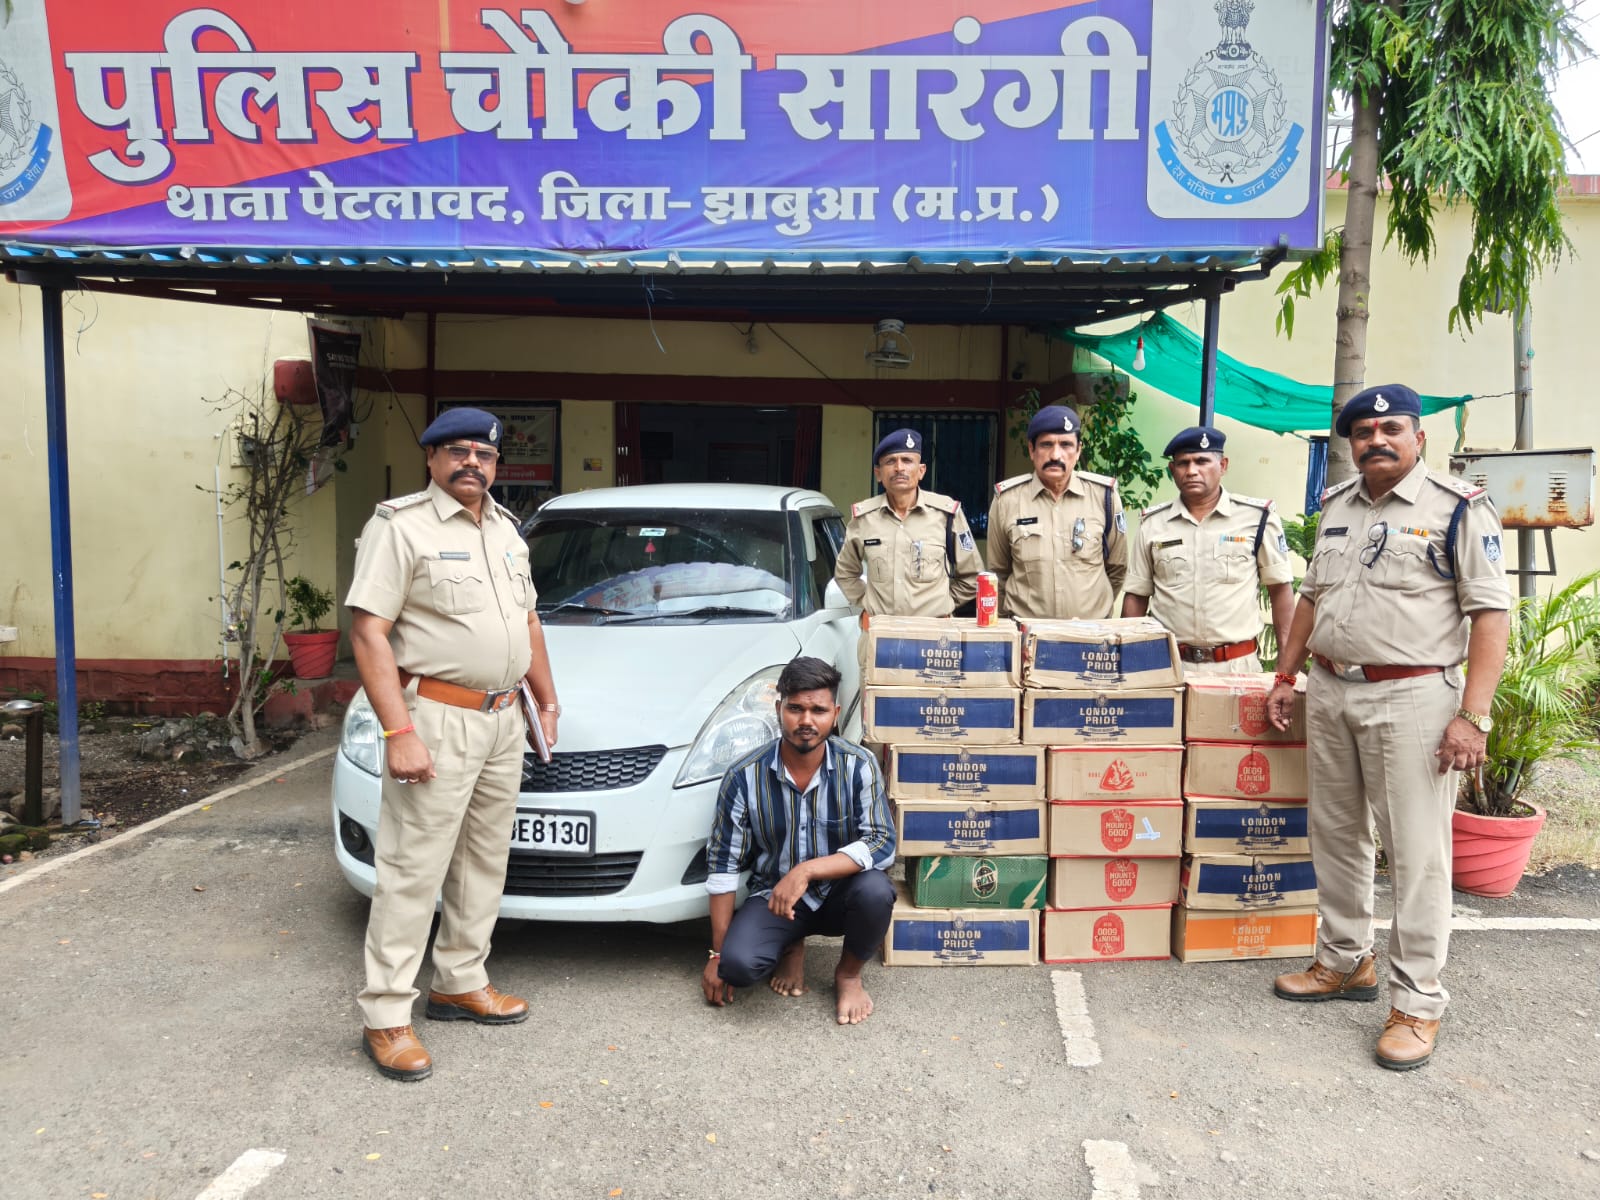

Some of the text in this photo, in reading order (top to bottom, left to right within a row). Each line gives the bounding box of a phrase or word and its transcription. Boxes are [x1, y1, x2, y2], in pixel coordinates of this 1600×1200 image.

[63, 9, 1149, 183] पुलिस चौकी सारंगी
[166, 184, 289, 222] थाना
[301, 171, 525, 226] पेटलावद,
[702, 184, 880, 237] झाबुआ
[892, 182, 1060, 223] (म.प्र.)
[926, 658, 960, 668] PRIDE
[1087, 661, 1118, 671] PRIDE
[920, 706, 965, 716] LONDON
[1079, 706, 1124, 716] LONDON
[926, 715, 959, 725] PRIDE
[1085, 716, 1118, 725] PRIDE
[943, 762, 987, 772] LONDON
[948, 771, 981, 781] PRIDE
[1105, 822, 1132, 830] MOUNTS
[1241, 817, 1286, 826] LONDON
[954, 829, 986, 838] PRIDE
[1108, 829, 1129, 837] 6000
[1247, 826, 1280, 835] PRIDE
[1112, 879, 1132, 887] 6000
[937, 930, 982, 939] LONDON
[1098, 927, 1118, 936] 6000
[1232, 924, 1272, 935] LONDON
[943, 939, 976, 948] PRIDE
[1237, 935, 1266, 945] PRIDE
